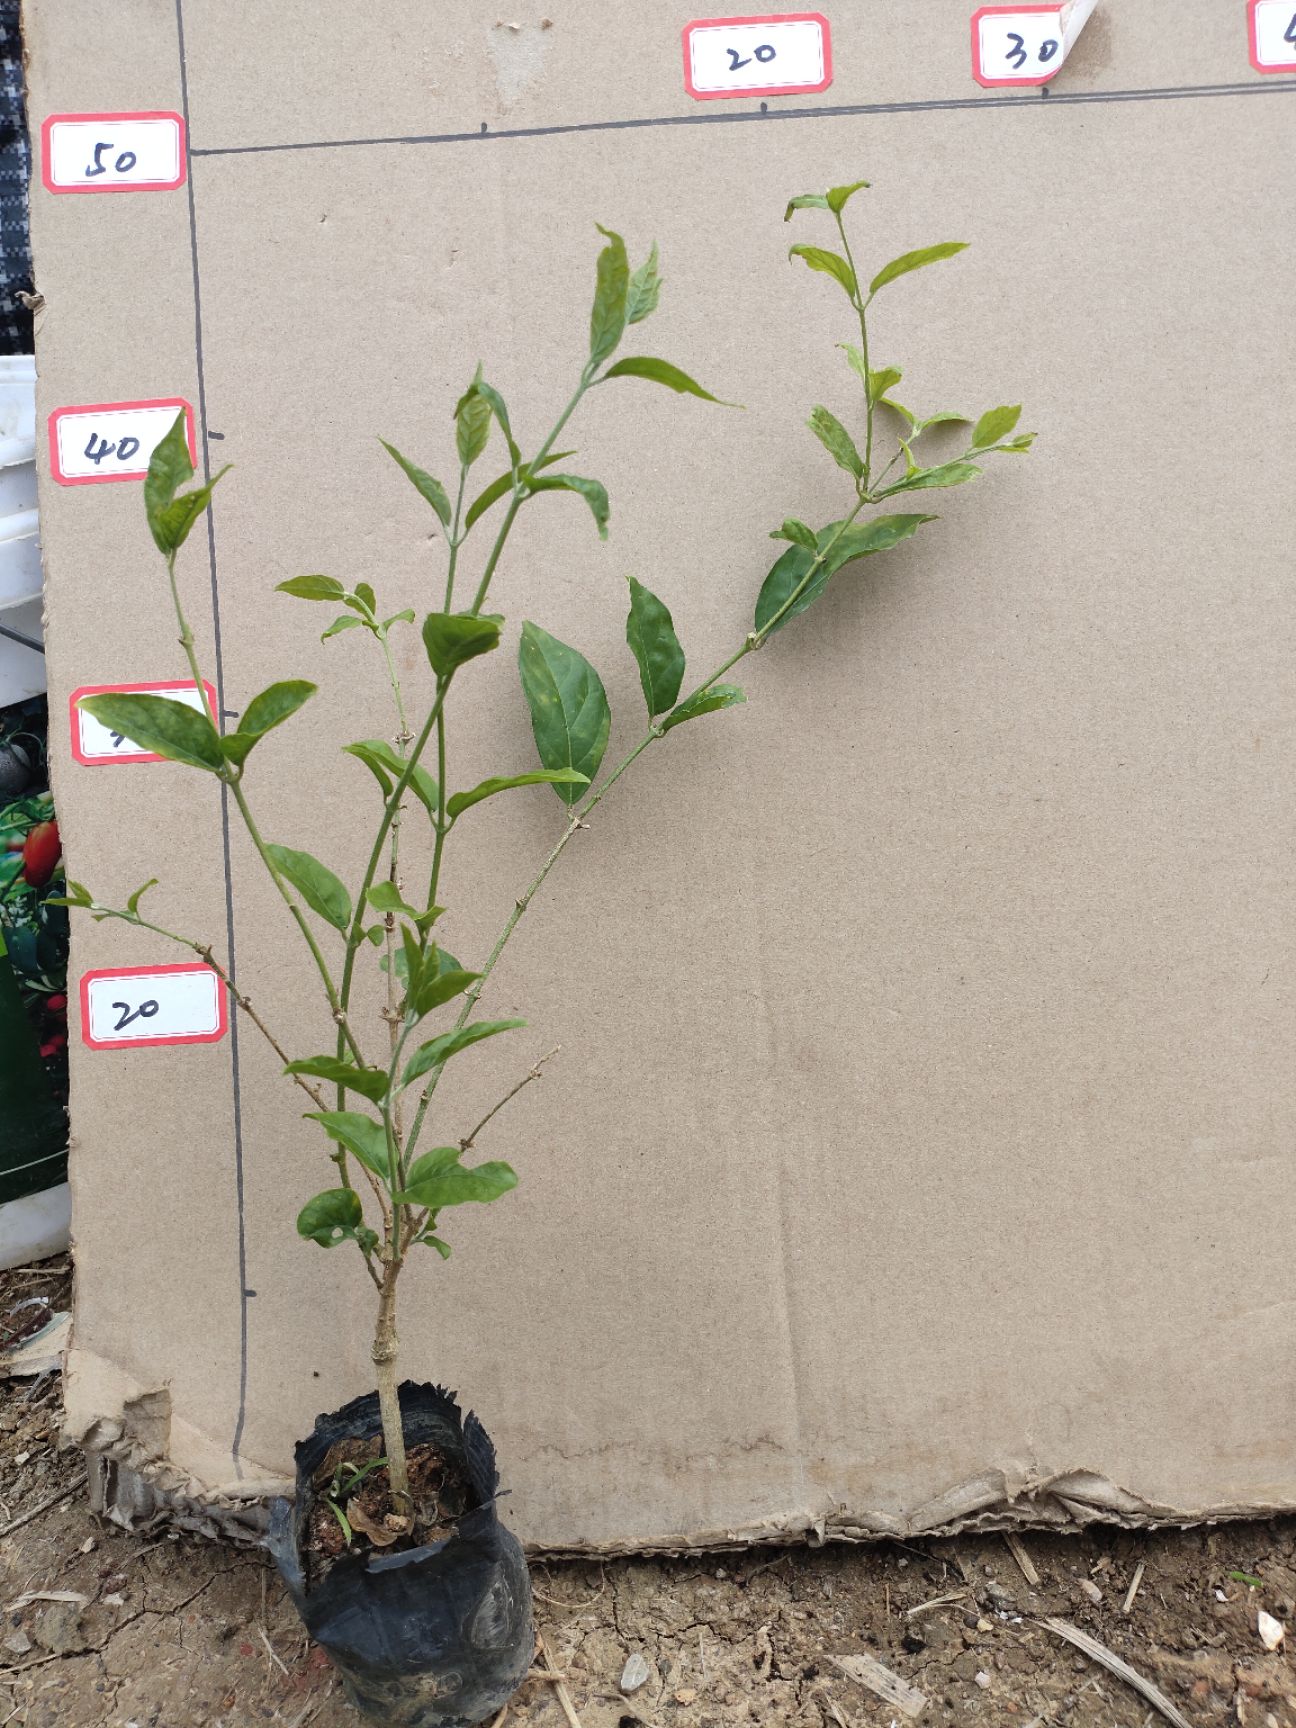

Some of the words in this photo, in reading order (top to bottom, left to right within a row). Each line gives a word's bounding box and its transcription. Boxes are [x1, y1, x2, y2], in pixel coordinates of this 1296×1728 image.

[726, 44, 777, 72] 20
[1005, 32, 1059, 69] 30
[85, 142, 137, 177] 50
[83, 432, 140, 465] 40
[111, 999, 160, 1032] 20
